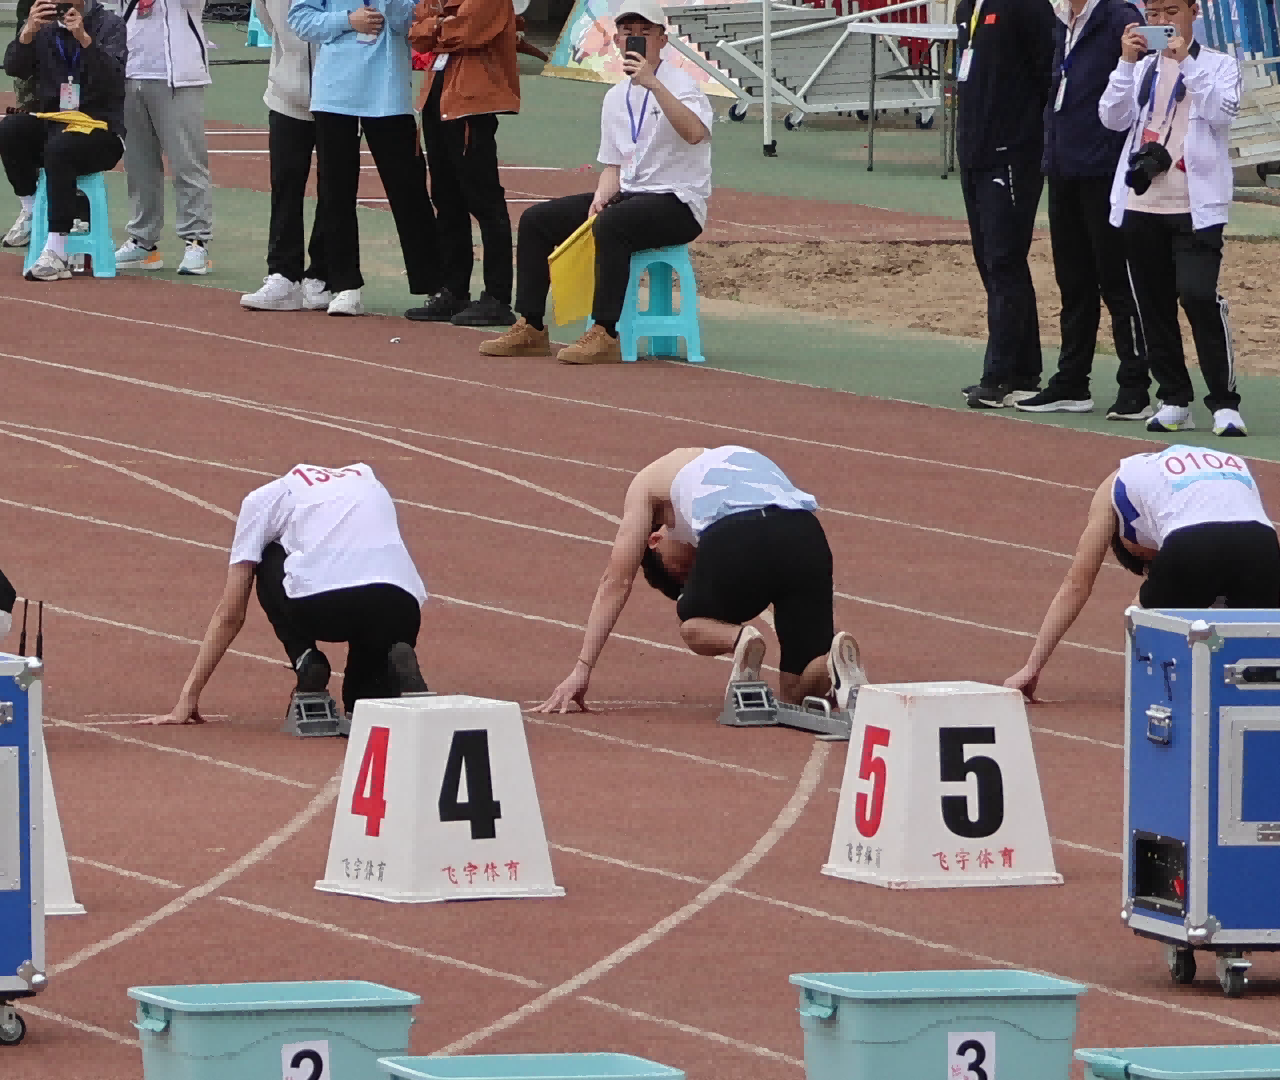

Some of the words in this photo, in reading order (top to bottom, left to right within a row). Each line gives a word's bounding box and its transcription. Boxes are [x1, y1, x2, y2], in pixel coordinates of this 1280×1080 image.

[1164, 452, 1244, 475] 0104
[351, 726, 391, 838] 4
[438, 728, 502, 840] 4
[854, 725, 891, 838] 5
[939, 726, 1005, 839] 5
[442, 859, 521, 885] 飞宇体育
[932, 846, 1016, 871] 飞宇体育
[955, 1039, 989, 1080] 3
